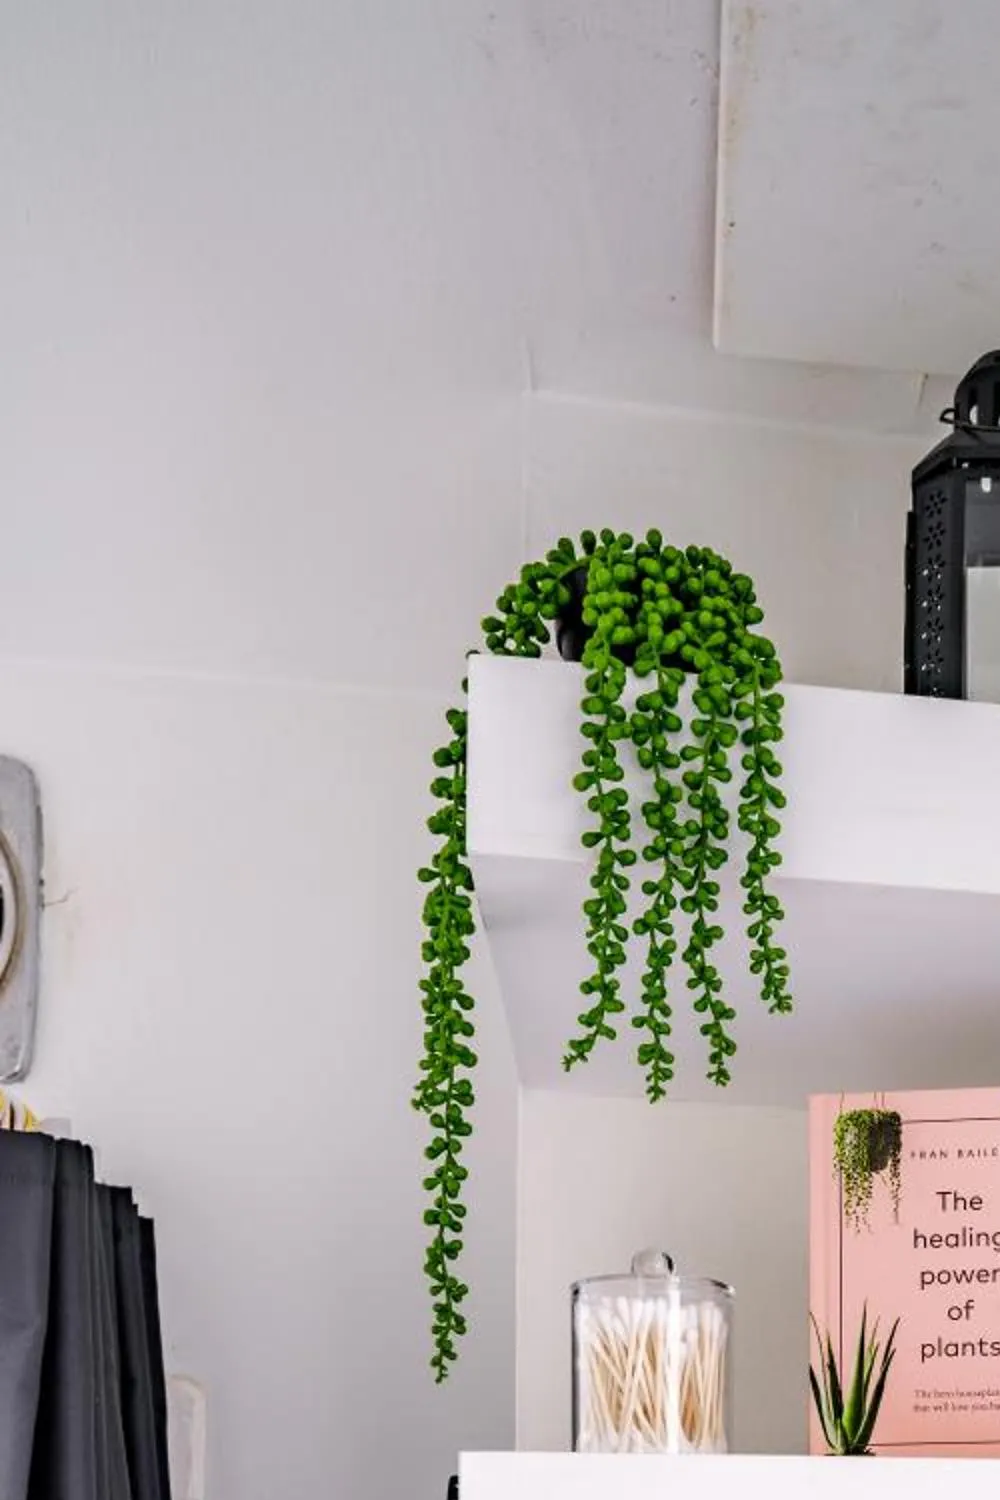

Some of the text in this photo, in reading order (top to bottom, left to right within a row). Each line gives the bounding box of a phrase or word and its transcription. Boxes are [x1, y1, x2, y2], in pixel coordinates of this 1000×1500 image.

[910, 1150, 948, 1159] FRAN
[935, 1190, 984, 1212] The
[946, 1298, 976, 1322] of
